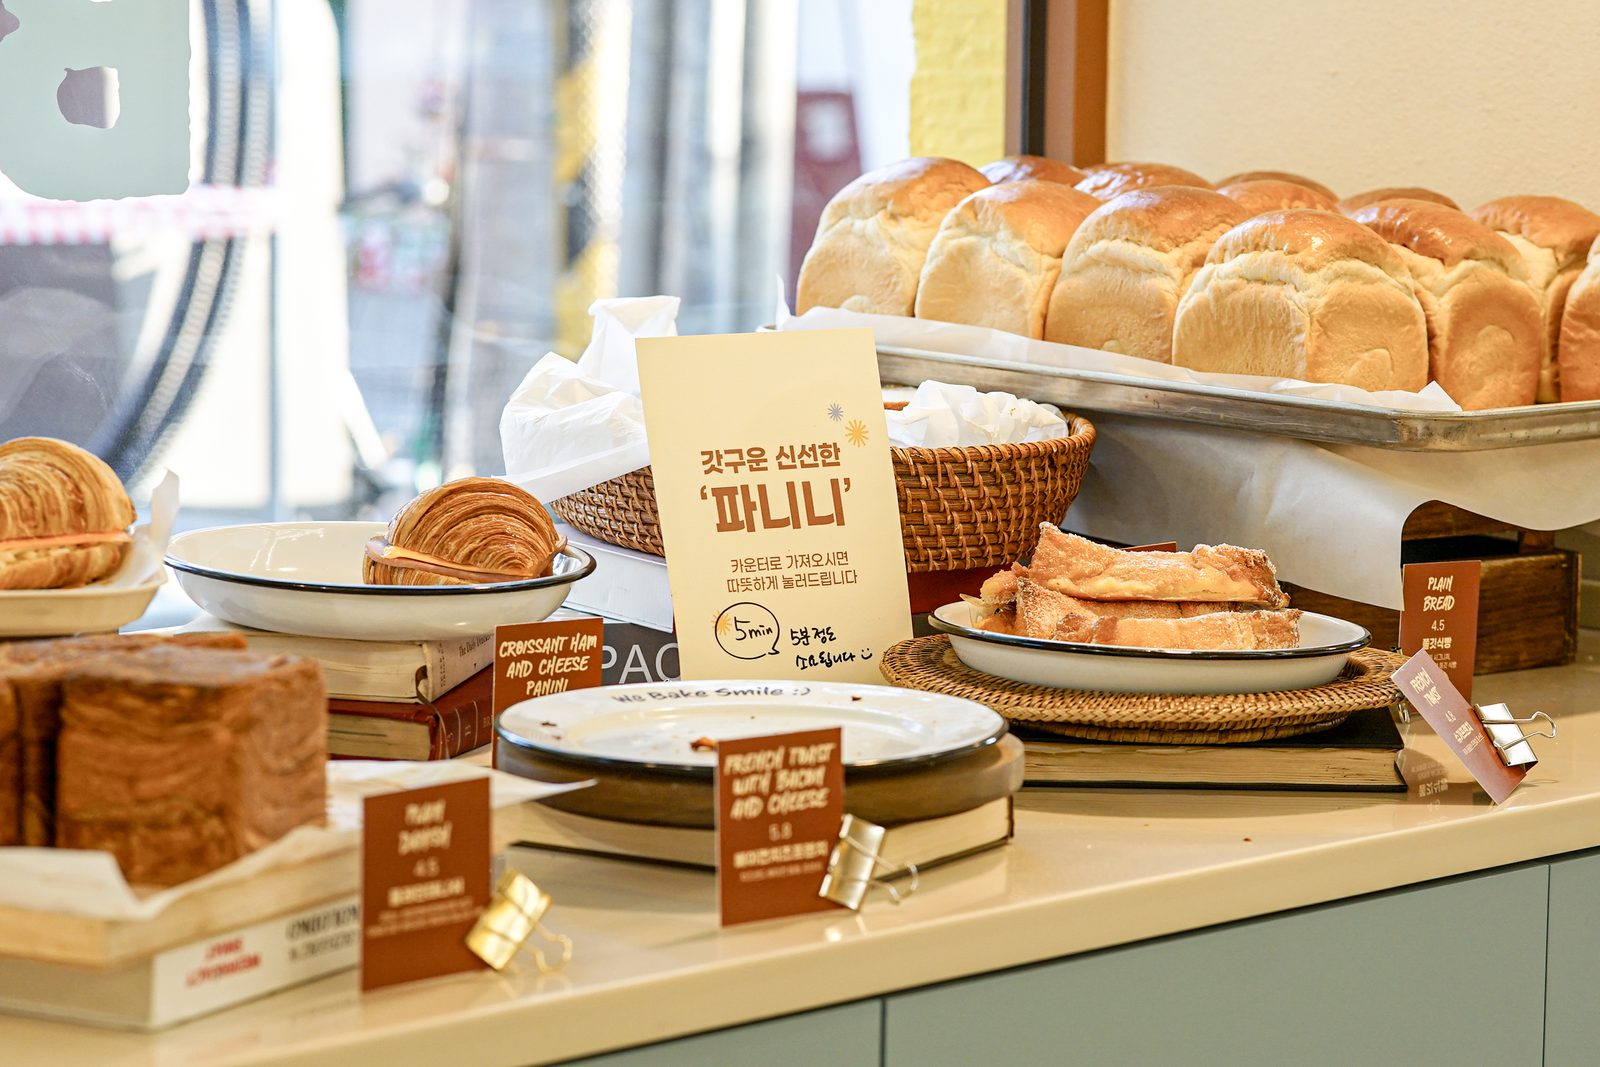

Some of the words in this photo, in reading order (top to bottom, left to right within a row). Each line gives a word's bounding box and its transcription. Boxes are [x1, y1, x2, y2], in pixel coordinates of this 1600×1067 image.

[700, 446, 769, 475] 갓구운
[775, 442, 841, 470] 신선한
[730, 556, 783, 574] 카운터로
[785, 551, 849, 569] 가져오시면
[726, 575, 779, 593] 따뜻하게
[781, 569, 858, 590] 눌러드립니다
[1427, 575, 1454, 592] PLAIN
[1422, 595, 1455, 612] BREAD
[1431, 619, 1445, 631] 4.5
[499, 636, 569, 658] CROISSANT
[570, 632, 598, 651] HAM
[505, 660, 533, 679] AND
[538, 655, 591, 676] CHEESE
[526, 677, 569, 697] PANINI
[611, 693, 646, 704] We
[649, 688, 709, 701] Bake
[715, 686, 784, 697] Smile
[724, 745, 786, 776] FRENCH
[732, 770, 772, 796] WITH
[776, 766, 827, 792] BACON
[730, 795, 764, 820] AND
[767, 787, 830, 815] CHEESE
